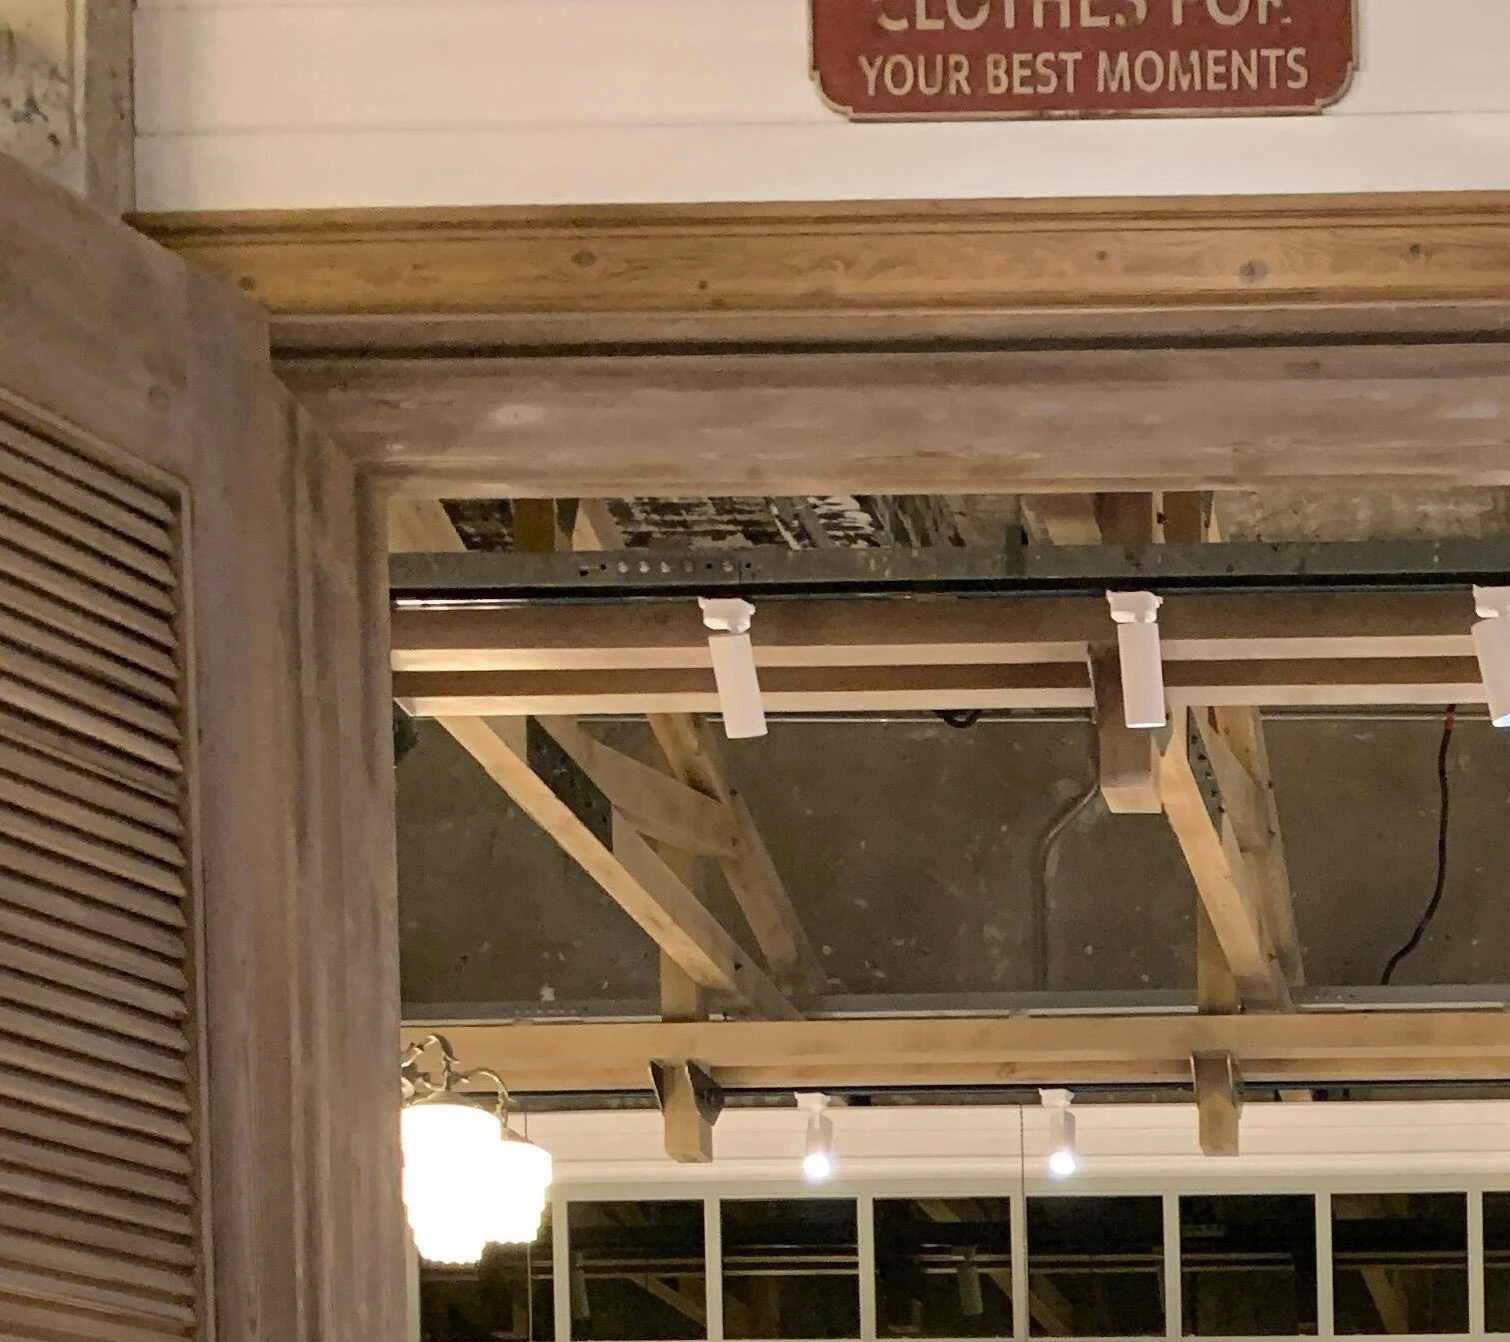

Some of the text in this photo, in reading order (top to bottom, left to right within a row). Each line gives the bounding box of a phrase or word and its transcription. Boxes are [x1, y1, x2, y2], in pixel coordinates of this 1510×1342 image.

[859, 48, 1309, 96] YOUR BEST MOMENTS
